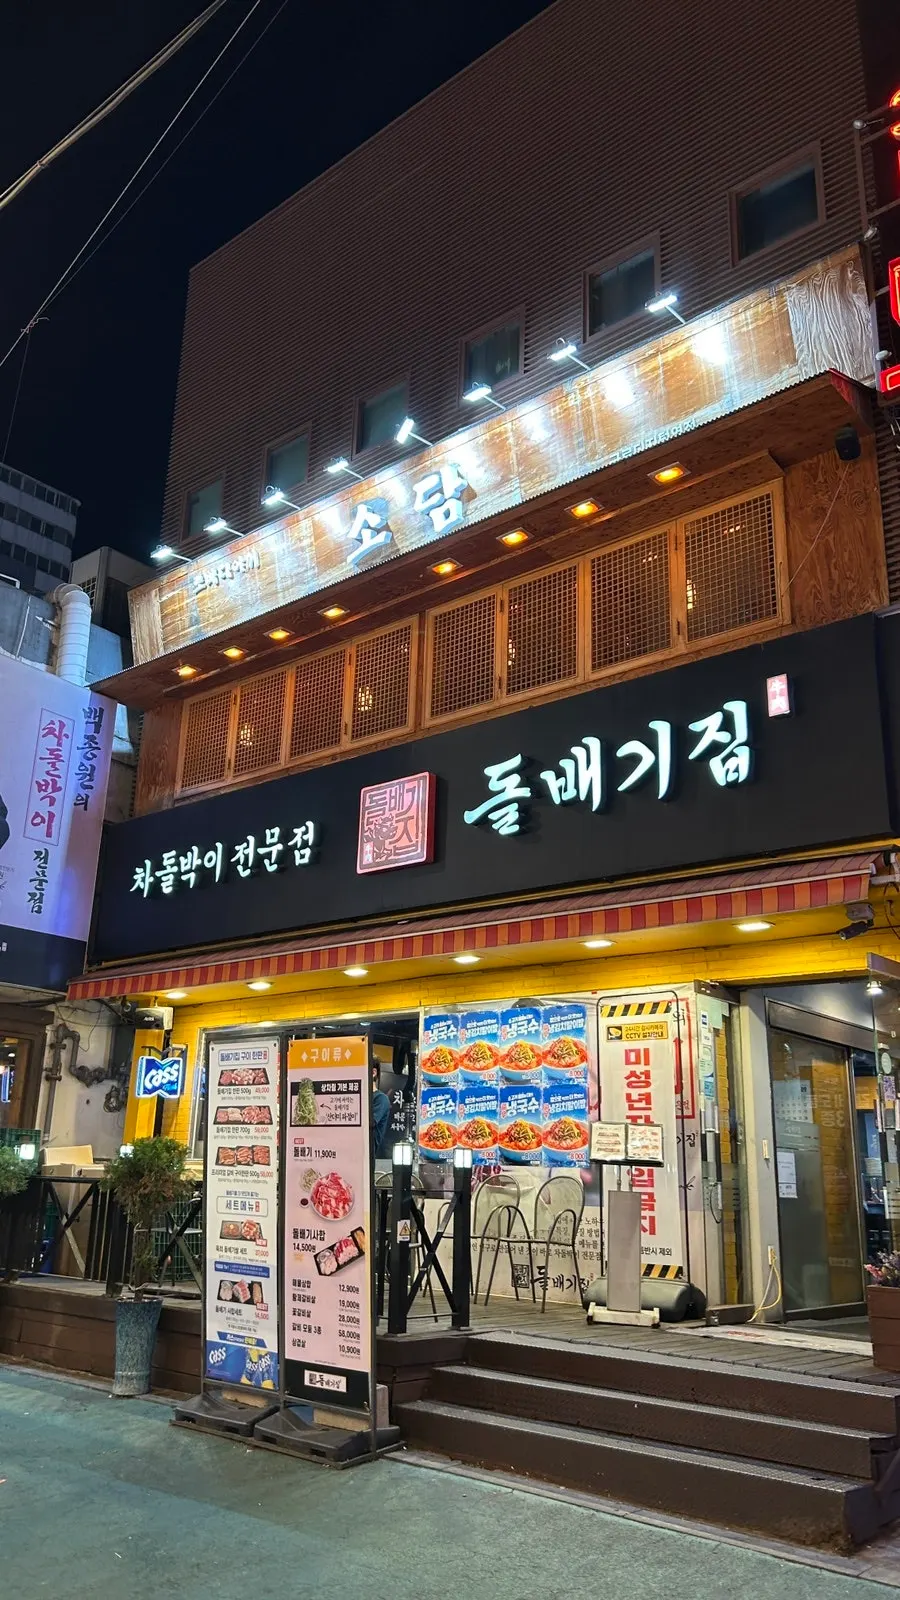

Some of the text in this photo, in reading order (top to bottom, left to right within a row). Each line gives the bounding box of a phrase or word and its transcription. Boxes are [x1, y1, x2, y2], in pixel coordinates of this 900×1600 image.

[347, 464, 467, 569] 소담
[73, 706, 105, 812] 백종원의
[463, 700, 751, 836] 돌배기집
[31, 718, 69, 838] 차돌박이
[129, 820, 315, 898] 차돌박이 전문점
[27, 847, 49, 914] 전문점
[429, 1024, 457, 1043] 냉국수
[506, 1019, 539, 1039] 냉국수
[337, 1083, 347, 1092] 기본
[427, 1099, 455, 1118] 냉국수
[506, 1097, 539, 1117] 냉국수
[293, 1147, 313, 1158] 돌배기
[658, 1247, 673, 1257] 제외
